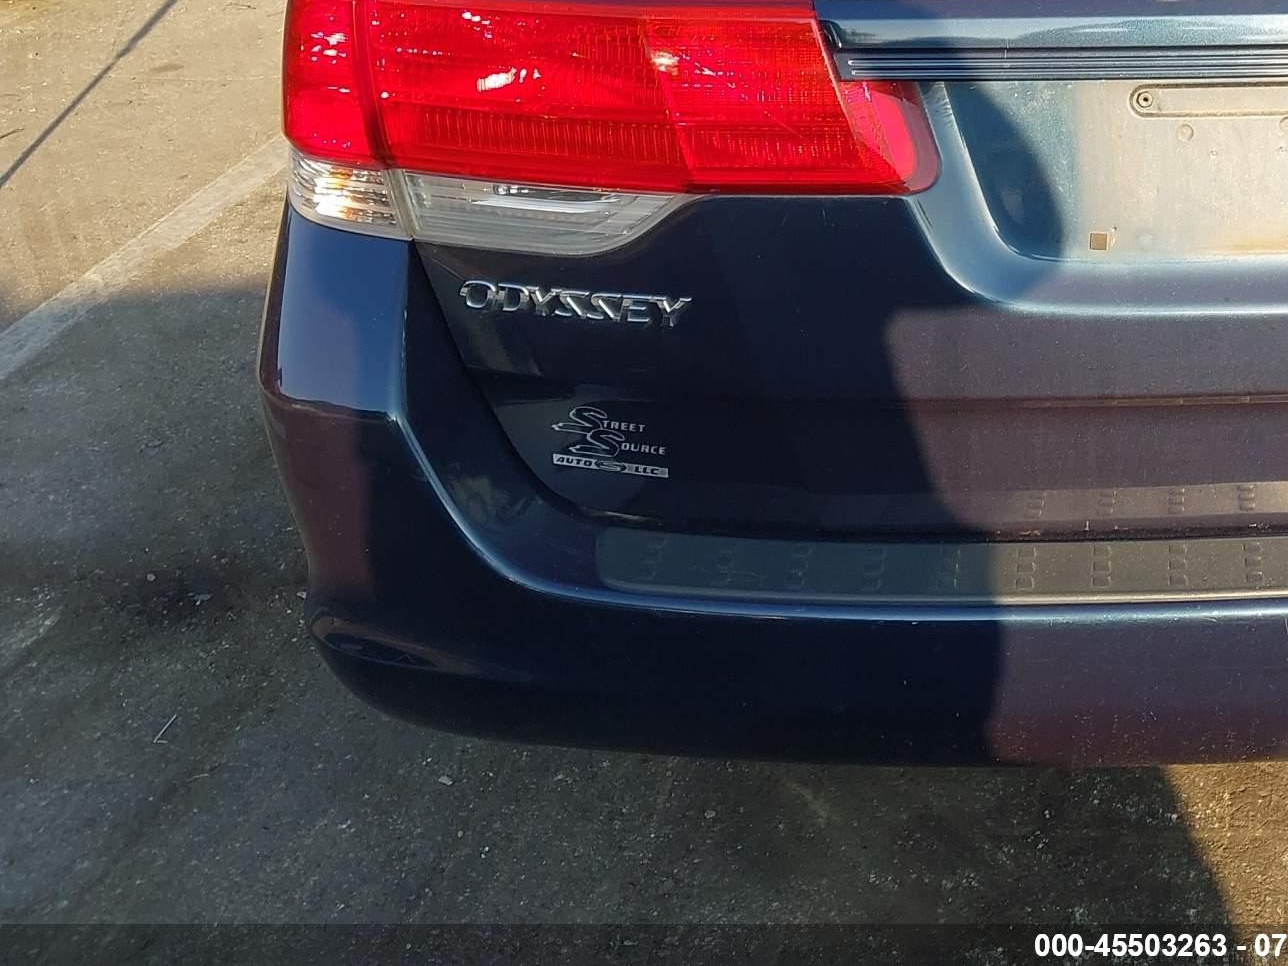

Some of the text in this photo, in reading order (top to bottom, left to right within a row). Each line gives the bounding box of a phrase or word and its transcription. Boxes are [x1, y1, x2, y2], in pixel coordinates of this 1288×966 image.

[459, 279, 693, 327] ODYSSEY
[551, 406, 647, 434] STREET
[568, 428, 667, 457] SOURCE
[555, 455, 593, 467] AUTO
[634, 466, 661, 475] LLC
